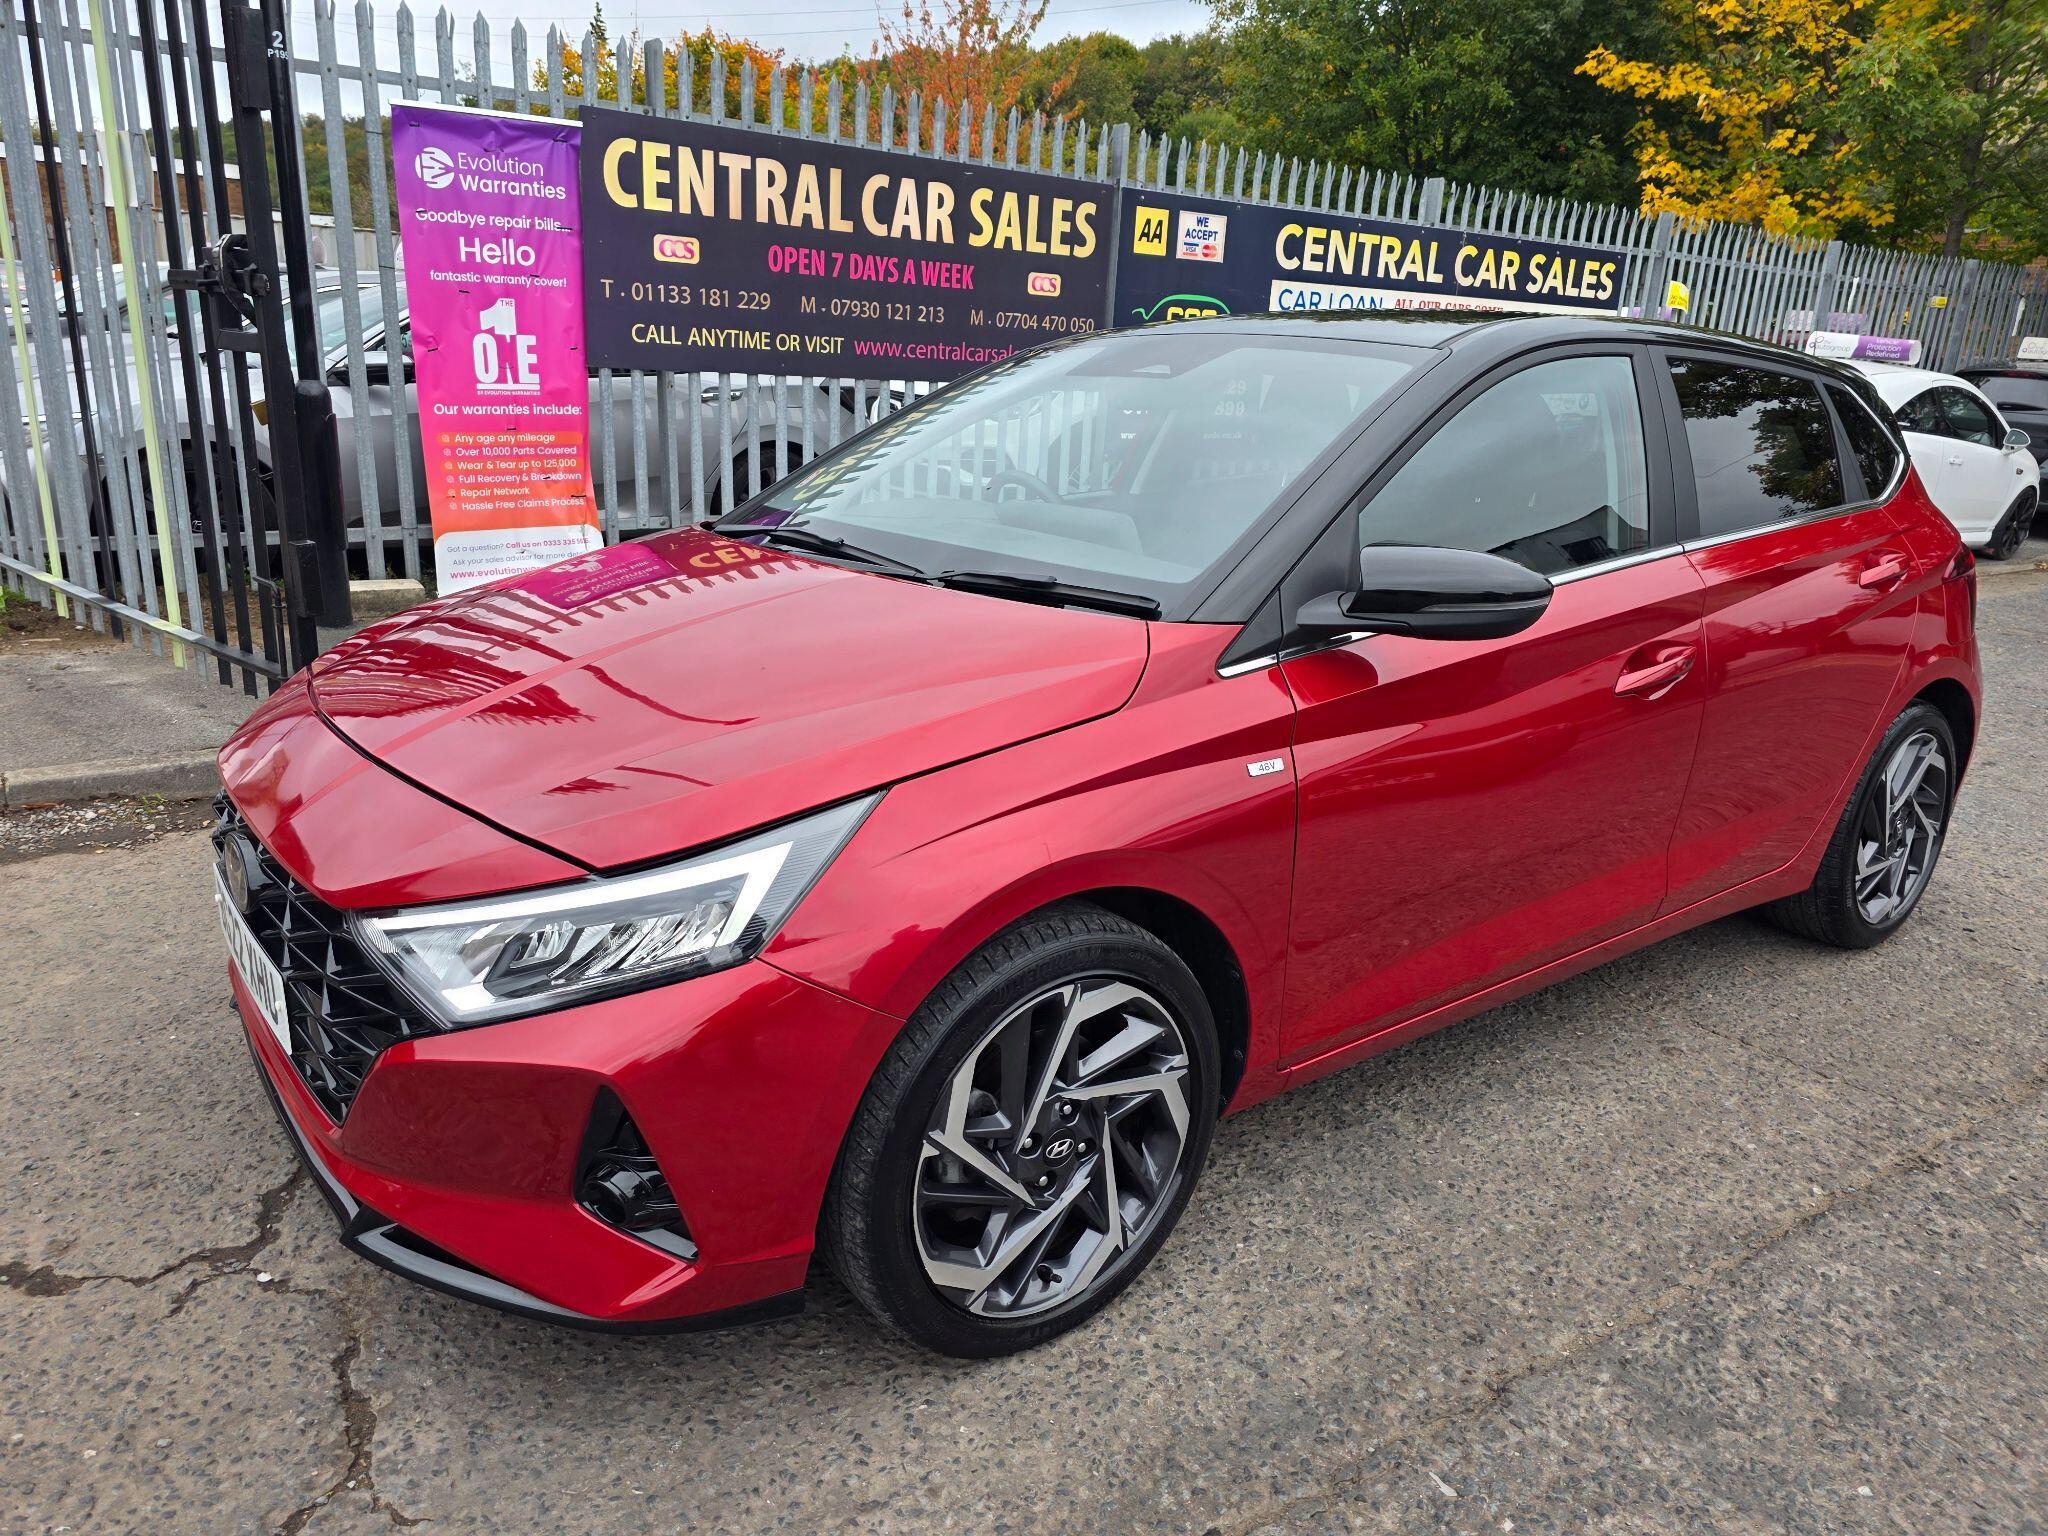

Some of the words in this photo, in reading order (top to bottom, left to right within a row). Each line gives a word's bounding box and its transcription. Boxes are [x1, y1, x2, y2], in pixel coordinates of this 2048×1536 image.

[271, 30, 283, 48] 2
[457, 152, 544, 177] Evolution
[459, 173, 566, 200] Warranties
[603, 137, 854, 233] CENTRAL
[861, 173, 955, 244] CAR
[968, 187, 1097, 258] SALES
[415, 207, 486, 229] Goodbye
[489, 215, 532, 231] repair
[1196, 216, 1210, 228] WE
[1137, 218, 1164, 244] AA
[1184, 227, 1219, 242] ACCEPT
[459, 236, 536, 267] Hello
[768, 244, 825, 277] OPEN
[831, 252, 844, 278] 7
[850, 253, 899, 283] DAYS
[903, 258, 916, 285] A
[921, 260, 975, 290] WEEK
[1275, 223, 1444, 284] CENTRAL
[1454, 245, 1521, 291] CAR
[1525, 253, 1617, 301] SALES
[430, 269, 481, 283] fantastic
[484, 273, 532, 288] warranty
[534, 277, 567, 288] cover!
[500, 299, 514, 307] THE
[631, 282, 691, 305] 01133
[699, 287, 729, 308] 181
[737, 290, 771, 310] 229
[1278, 288, 1322, 310] CAR
[831, 298, 880, 319] 07930
[886, 303, 911, 321] 121
[917, 305, 945, 323] 213
[996, 311, 1038, 330] 07704
[1041, 315, 1066, 332] 470
[1070, 317, 1094, 333] 050
[631, 323, 682, 345] CALL
[687, 327, 771, 350] ANYTIME
[776, 333, 800, 352] OR
[804, 335, 844, 354] VISIT
[854, 339, 1019, 363] www.centralcarsal
[1866, 343, 1901, 352] Protection
[1865, 349, 1900, 359] Redefined
[433, 404, 458, 415] Our
[462, 405, 530, 415] warranties
[533, 403, 583, 415] include:
[455, 434, 474, 444] Any
[476, 435, 495, 444] age
[498, 434, 516, 444] any
[518, 433, 556, 444] mileage
[456, 447, 480, 457] Over
[482, 446, 511, 457] 10,000
[513, 446, 534, 456] Parts
[537, 446, 577, 455] Covered
[457, 461, 483, 470] Wear
[486, 461, 493, 469] &
[495, 460, 516, 469] Tear
[518, 461, 530, 470] up
[532, 460, 541, 468] to
[544, 459, 577, 469] 125,000
[459, 475, 475, 484] Full
[478, 473, 520, 484] Recovery
[522, 472, 529, 481] &
[531, 472, 582, 482] Breakdown
[460, 488, 491, 498] Repair
[494, 486, 530, 496] Network
[462, 500, 493, 511] Hassle
[496, 499, 515, 509] Free
[517, 498, 549, 508] Claims
[551, 497, 585, 507] Process
[447, 545, 461, 553] Got
[469, 542, 504, 553] question?
[506, 541, 521, 549] Call
[453, 558, 466, 567] Ask
[467, 557, 484, 568] your
[485, 555, 505, 564] sales
[505, 552, 533, 563] advisor
[534, 551, 545, 560] for
[546, 551, 566, 560] more
